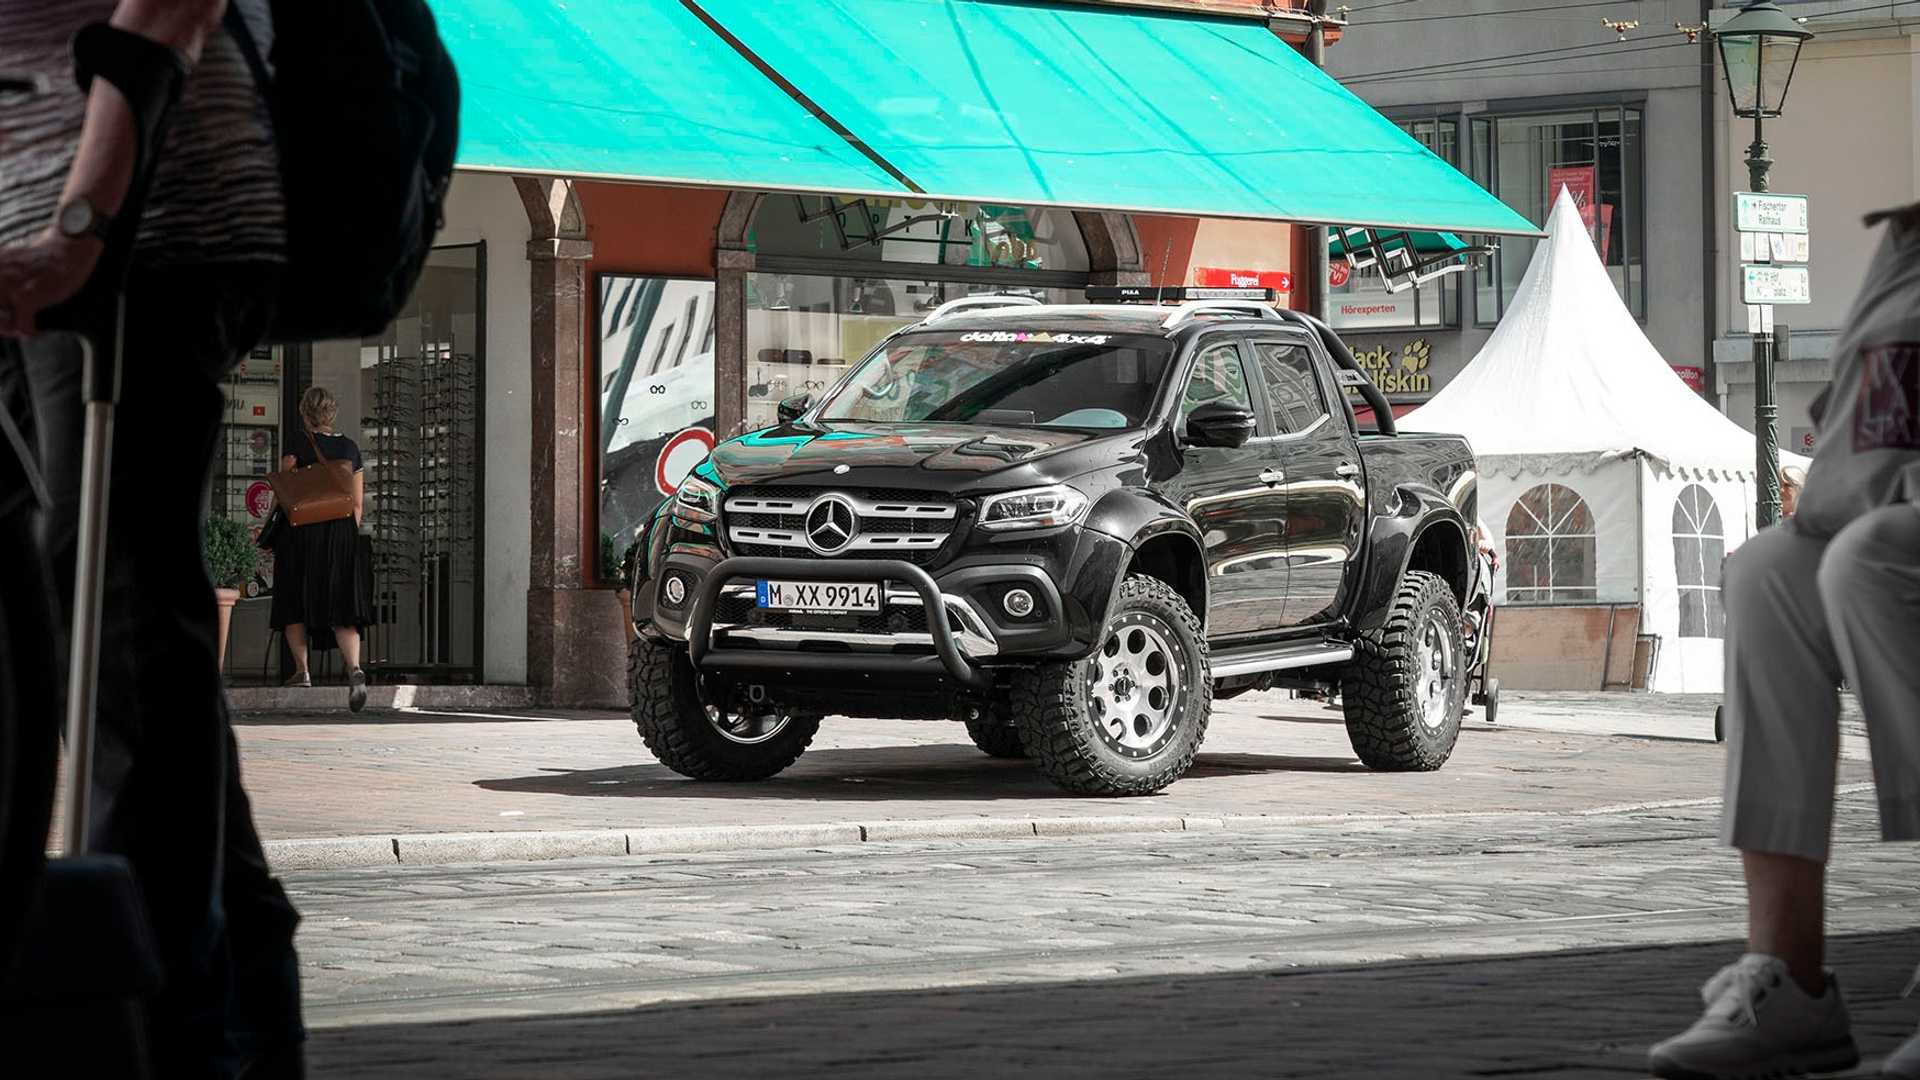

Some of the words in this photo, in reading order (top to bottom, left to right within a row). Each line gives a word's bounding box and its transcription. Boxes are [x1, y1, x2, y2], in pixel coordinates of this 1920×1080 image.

[1340, 303, 1396, 316] Hörexperten
[769, 584, 782, 605] M
[795, 585, 821, 606] XX
[826, 586, 876, 608] 9914
